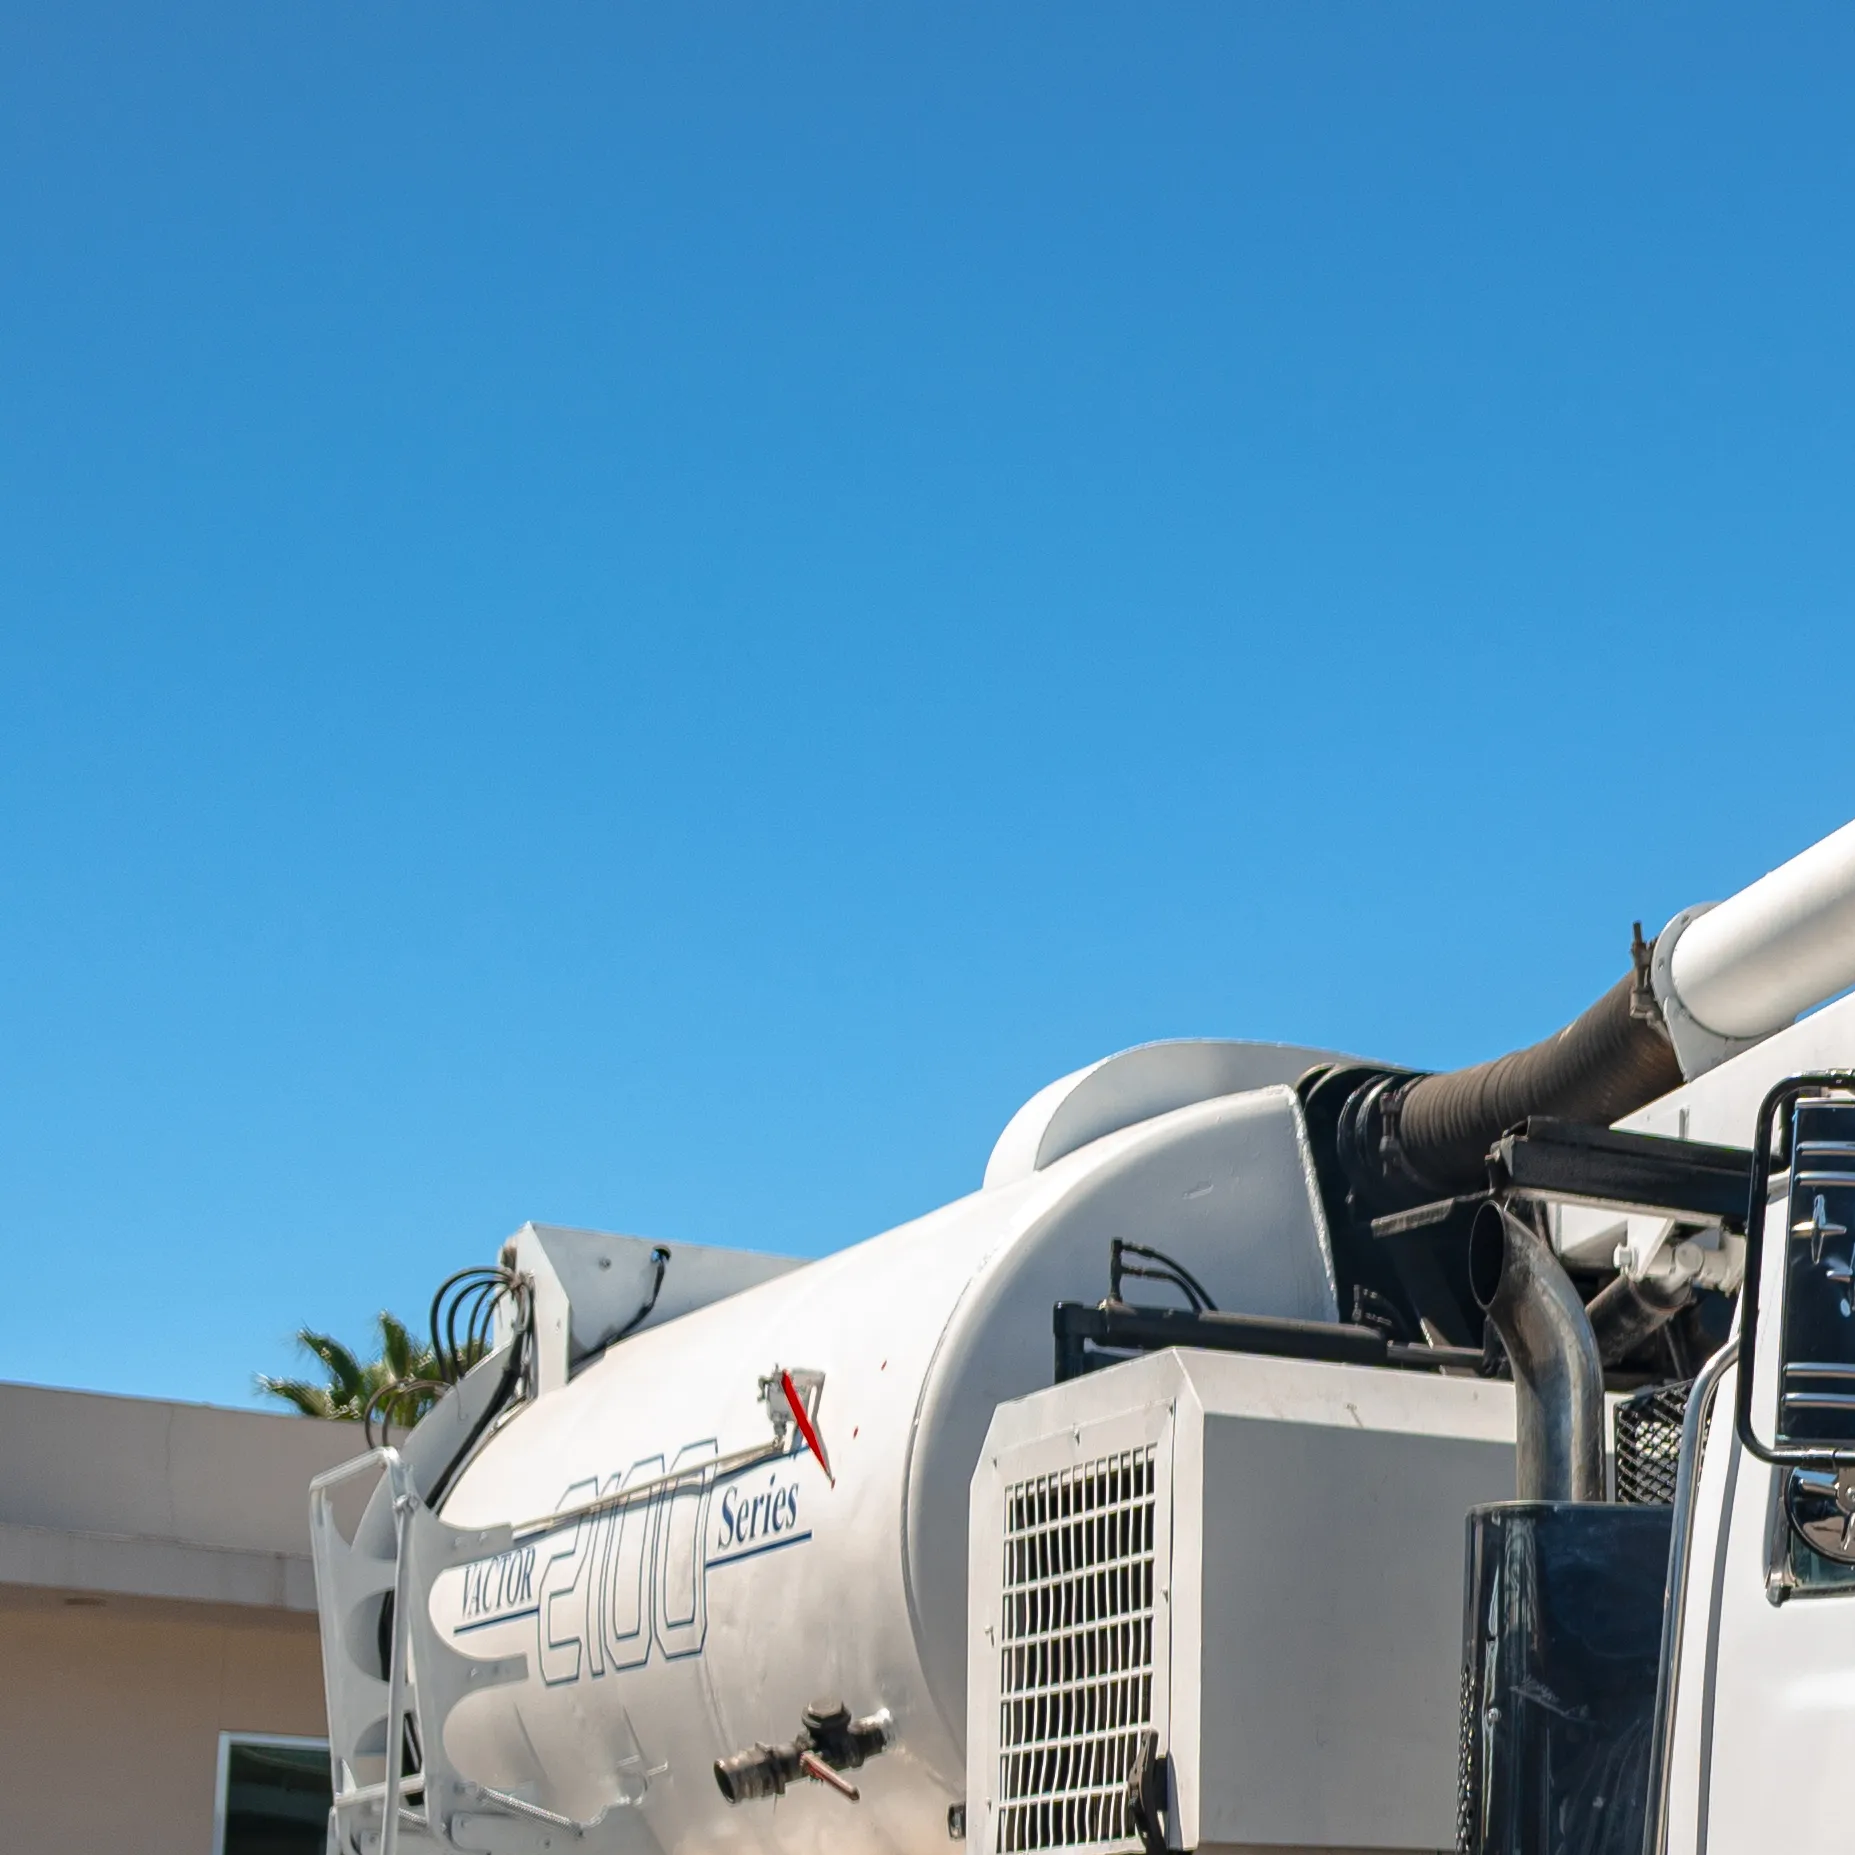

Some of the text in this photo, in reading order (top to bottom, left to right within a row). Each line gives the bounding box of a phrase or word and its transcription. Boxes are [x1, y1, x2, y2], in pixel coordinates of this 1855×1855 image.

[461, 1437, 800, 1687] VACTOR 2100 Series
